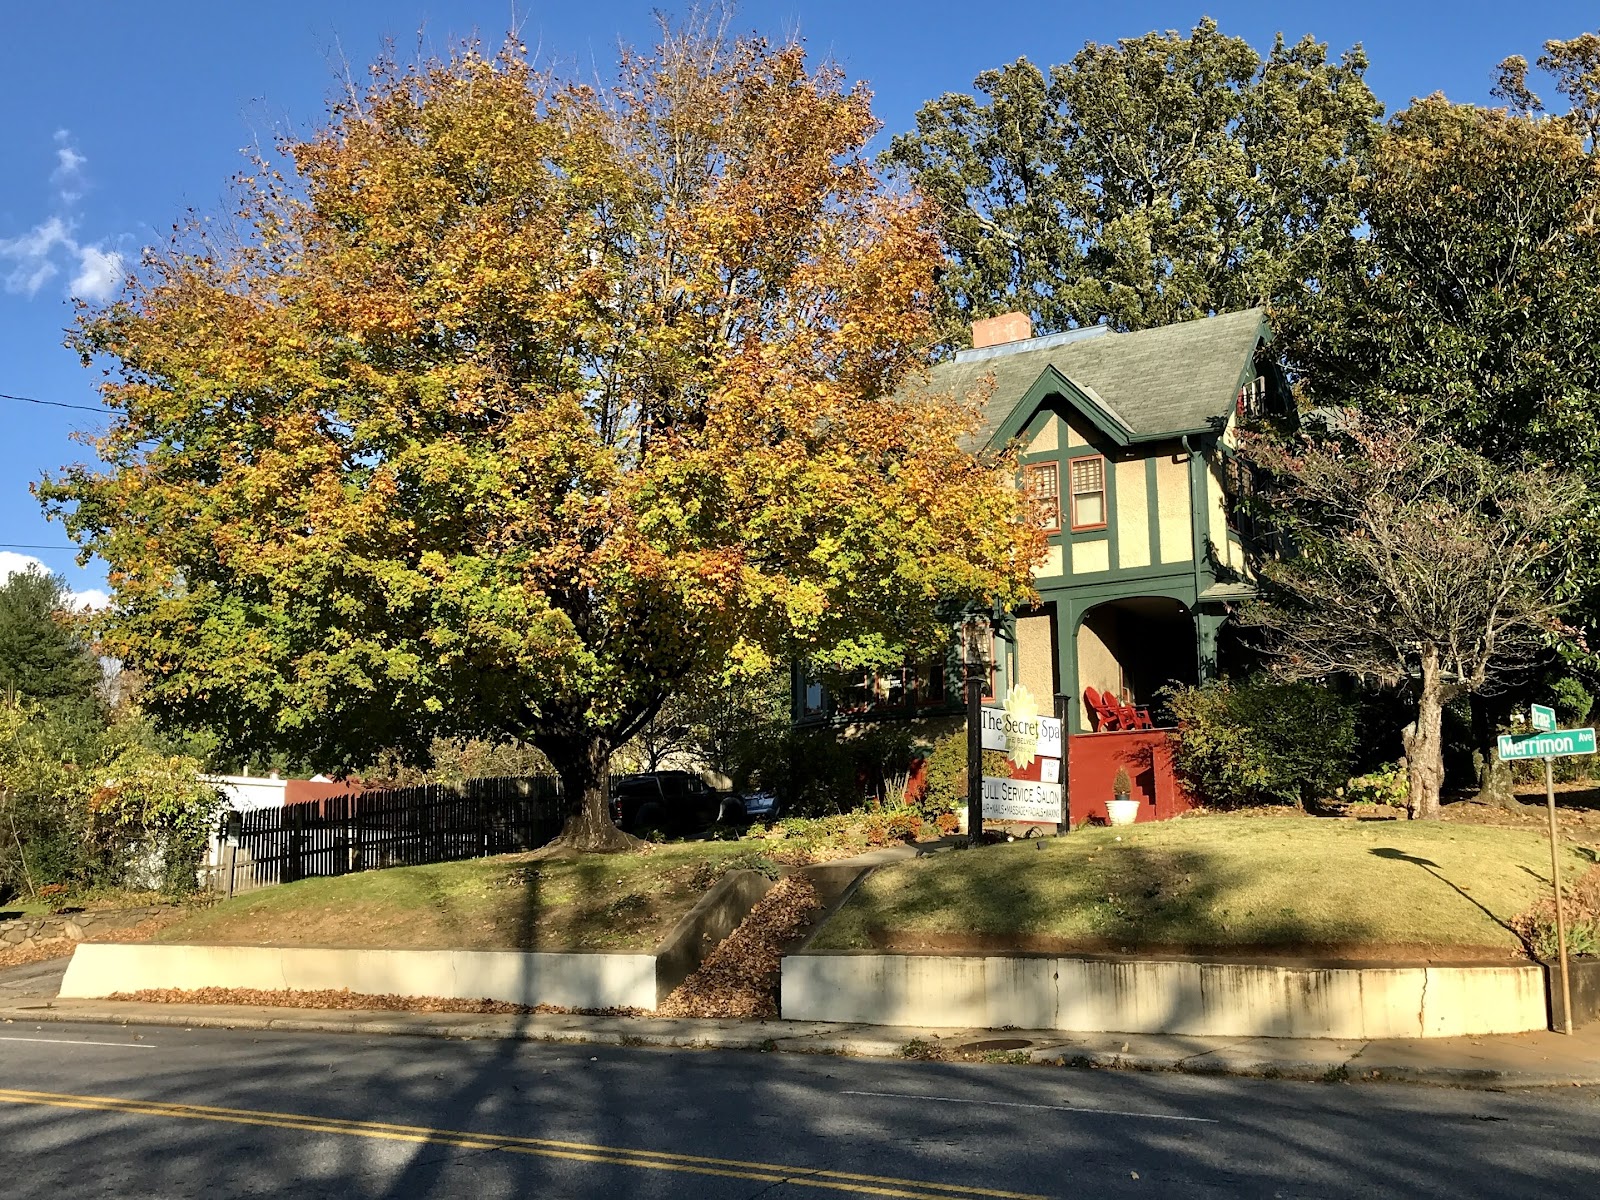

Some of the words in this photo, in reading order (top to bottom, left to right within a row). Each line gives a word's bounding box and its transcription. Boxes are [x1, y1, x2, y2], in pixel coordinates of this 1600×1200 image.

[981, 710, 1003, 731] The
[1005, 713, 1039, 740] Secret
[1041, 719, 1060, 742] Spa
[1501, 736, 1574, 757] Merrimon
[1578, 732, 1593, 742] Ave
[1001, 782, 1034, 803] SERVICE
[1036, 785, 1059, 805] SALON
